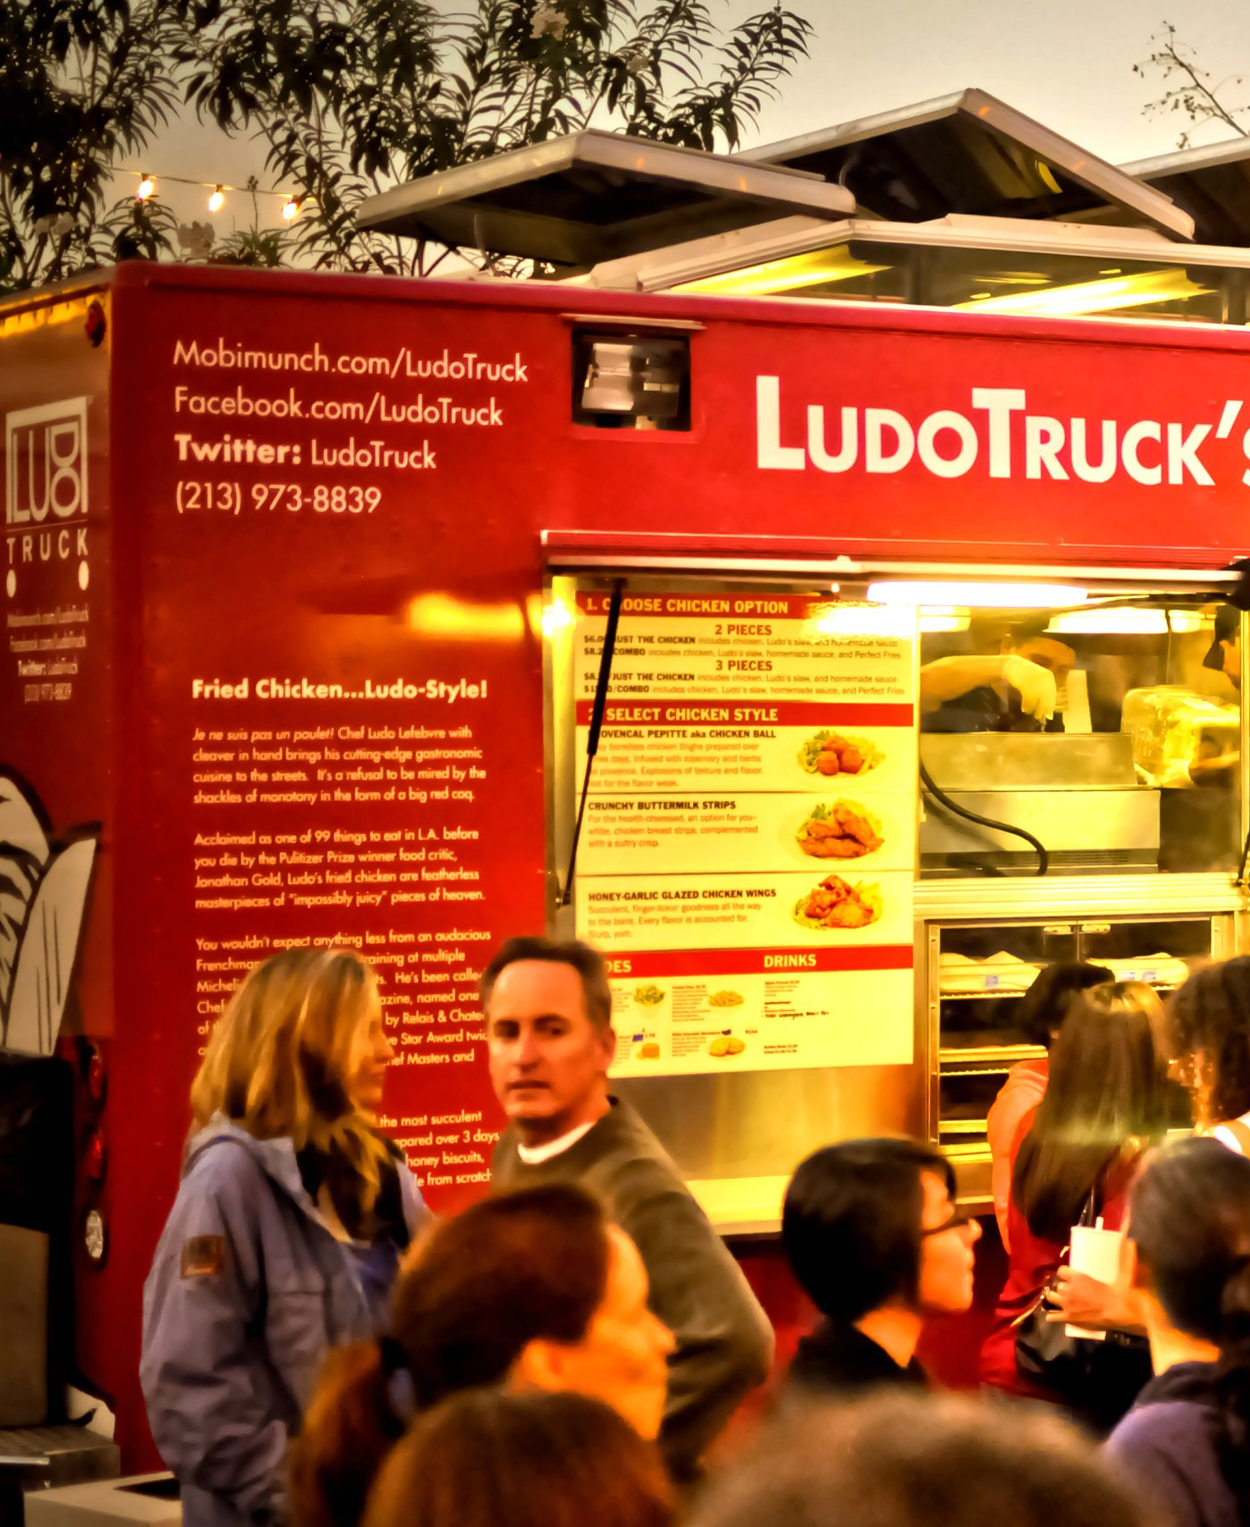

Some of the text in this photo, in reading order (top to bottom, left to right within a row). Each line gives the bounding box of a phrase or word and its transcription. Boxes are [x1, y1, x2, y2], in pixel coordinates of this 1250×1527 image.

[173, 337, 528, 383] Mobimunch.com/LudoTruck
[174, 385, 504, 427] Facebook.com/LudoTruck
[173, 433, 437, 470] Twitter: LudoTruck
[176, 480, 382, 517] (213) 973-8839
[7, 528, 88, 562] TRUCK
[601, 596, 789, 615] COOSE CHICKEN OPTION
[714, 623, 773, 636] 2 PIECES
[656, 634, 696, 645] CHICKEN
[715, 659, 773, 672] 3 PIECES
[656, 672, 695, 682] CHICKEN
[192, 678, 249, 699] Fried
[606, 707, 779, 722] SELECT CHICKEN STYLE
[192, 726, 206, 741] Je
[208, 730, 224, 741] ne
[226, 727, 249, 741] suis
[250, 729, 273, 744] pas
[275, 730, 291, 742] un
[337, 724, 366, 740] Chef
[367, 724, 396, 740] Ludo
[398, 724, 447, 741] Lefebvre
[448, 724, 473, 740] with
[589, 728, 776, 740] OVENCAL PEPITTE aka CHICKEN BALL
[192, 747, 235, 762] cleaver
[238, 751, 250, 762] in
[252, 747, 284, 762] hand
[285, 747, 322, 765] brings
[323, 746, 341, 762] his
[415, 746, 483, 763] gastronomic
[192, 771, 233, 783] cuisine
[235, 770, 248, 783] to
[249, 767, 269, 783] the
[334, 770, 344, 782] a
[345, 766, 384, 782] refusal
[385, 768, 398, 781] to
[399, 765, 416, 780] be
[417, 765, 451, 781] mired
[451, 765, 467, 784] by
[468, 765, 487, 780] the
[193, 788, 243, 805] shackles
[244, 788, 258, 805] of
[259, 790, 318, 807] monotony
[320, 790, 332, 803] in
[333, 786, 352, 802] the
[354, 786, 382, 802] form
[382, 786, 396, 802] of
[397, 791, 407, 802] a
[408, 785, 428, 804] big
[429, 785, 450, 801] red
[587, 800, 736, 812] CRUNCHY BUTTERMILK STRIPS
[193, 830, 257, 846] Acclaimed
[258, 834, 273, 846] as
[274, 833, 298, 845] one
[299, 829, 313, 845] of
[314, 829, 331, 844] 99
[333, 828, 368, 846] things
[369, 830, 382, 843] to
[383, 830, 402, 843] eat
[404, 828, 416, 842] in
[442, 827, 480, 841] before
[194, 856, 217, 871] you
[218, 852, 239, 868] die
[240, 851, 256, 869] by
[257, 850, 277, 866] the
[326, 850, 356, 865] Prize
[357, 849, 397, 863] winner
[398, 847, 426, 863] food
[195, 873, 249, 888] Jonathan
[287, 871, 323, 887] Ludo's
[354, 868, 397, 885] chicken
[399, 872, 419, 883] are
[420, 867, 480, 882] featherless
[194, 894, 271, 912] masterpieces
[272, 891, 286, 908] of
[390, 889, 427, 906] pieces
[428, 887, 441, 903] of
[588, 888, 777, 903] HONEY-GARLIC GLAZED CHICKEN WINGS
[195, 937, 219, 952] You
[272, 934, 311, 953] expect
[313, 932, 363, 951] anything
[365, 931, 387, 946] less
[388, 931, 416, 944] from
[417, 932, 433, 944] an
[434, 928, 492, 943] audacious
[407, 948, 466, 966] at multiple
[763, 953, 817, 969] DRINKS
[394, 968, 451, 985] He's been
[416, 987, 456, 1005] named
[457, 991, 481, 1003] one
[384, 1009, 435, 1030] by Relais
[400, 1027, 464, 1046] Star Award
[406, 1048, 475, 1066] Masters and
[378, 1108, 483, 1129] the most succulent
[434, 1127, 502, 1146] over 3 days
[404, 1151, 440, 1171] honey
[426, 1170, 453, 1187] from
